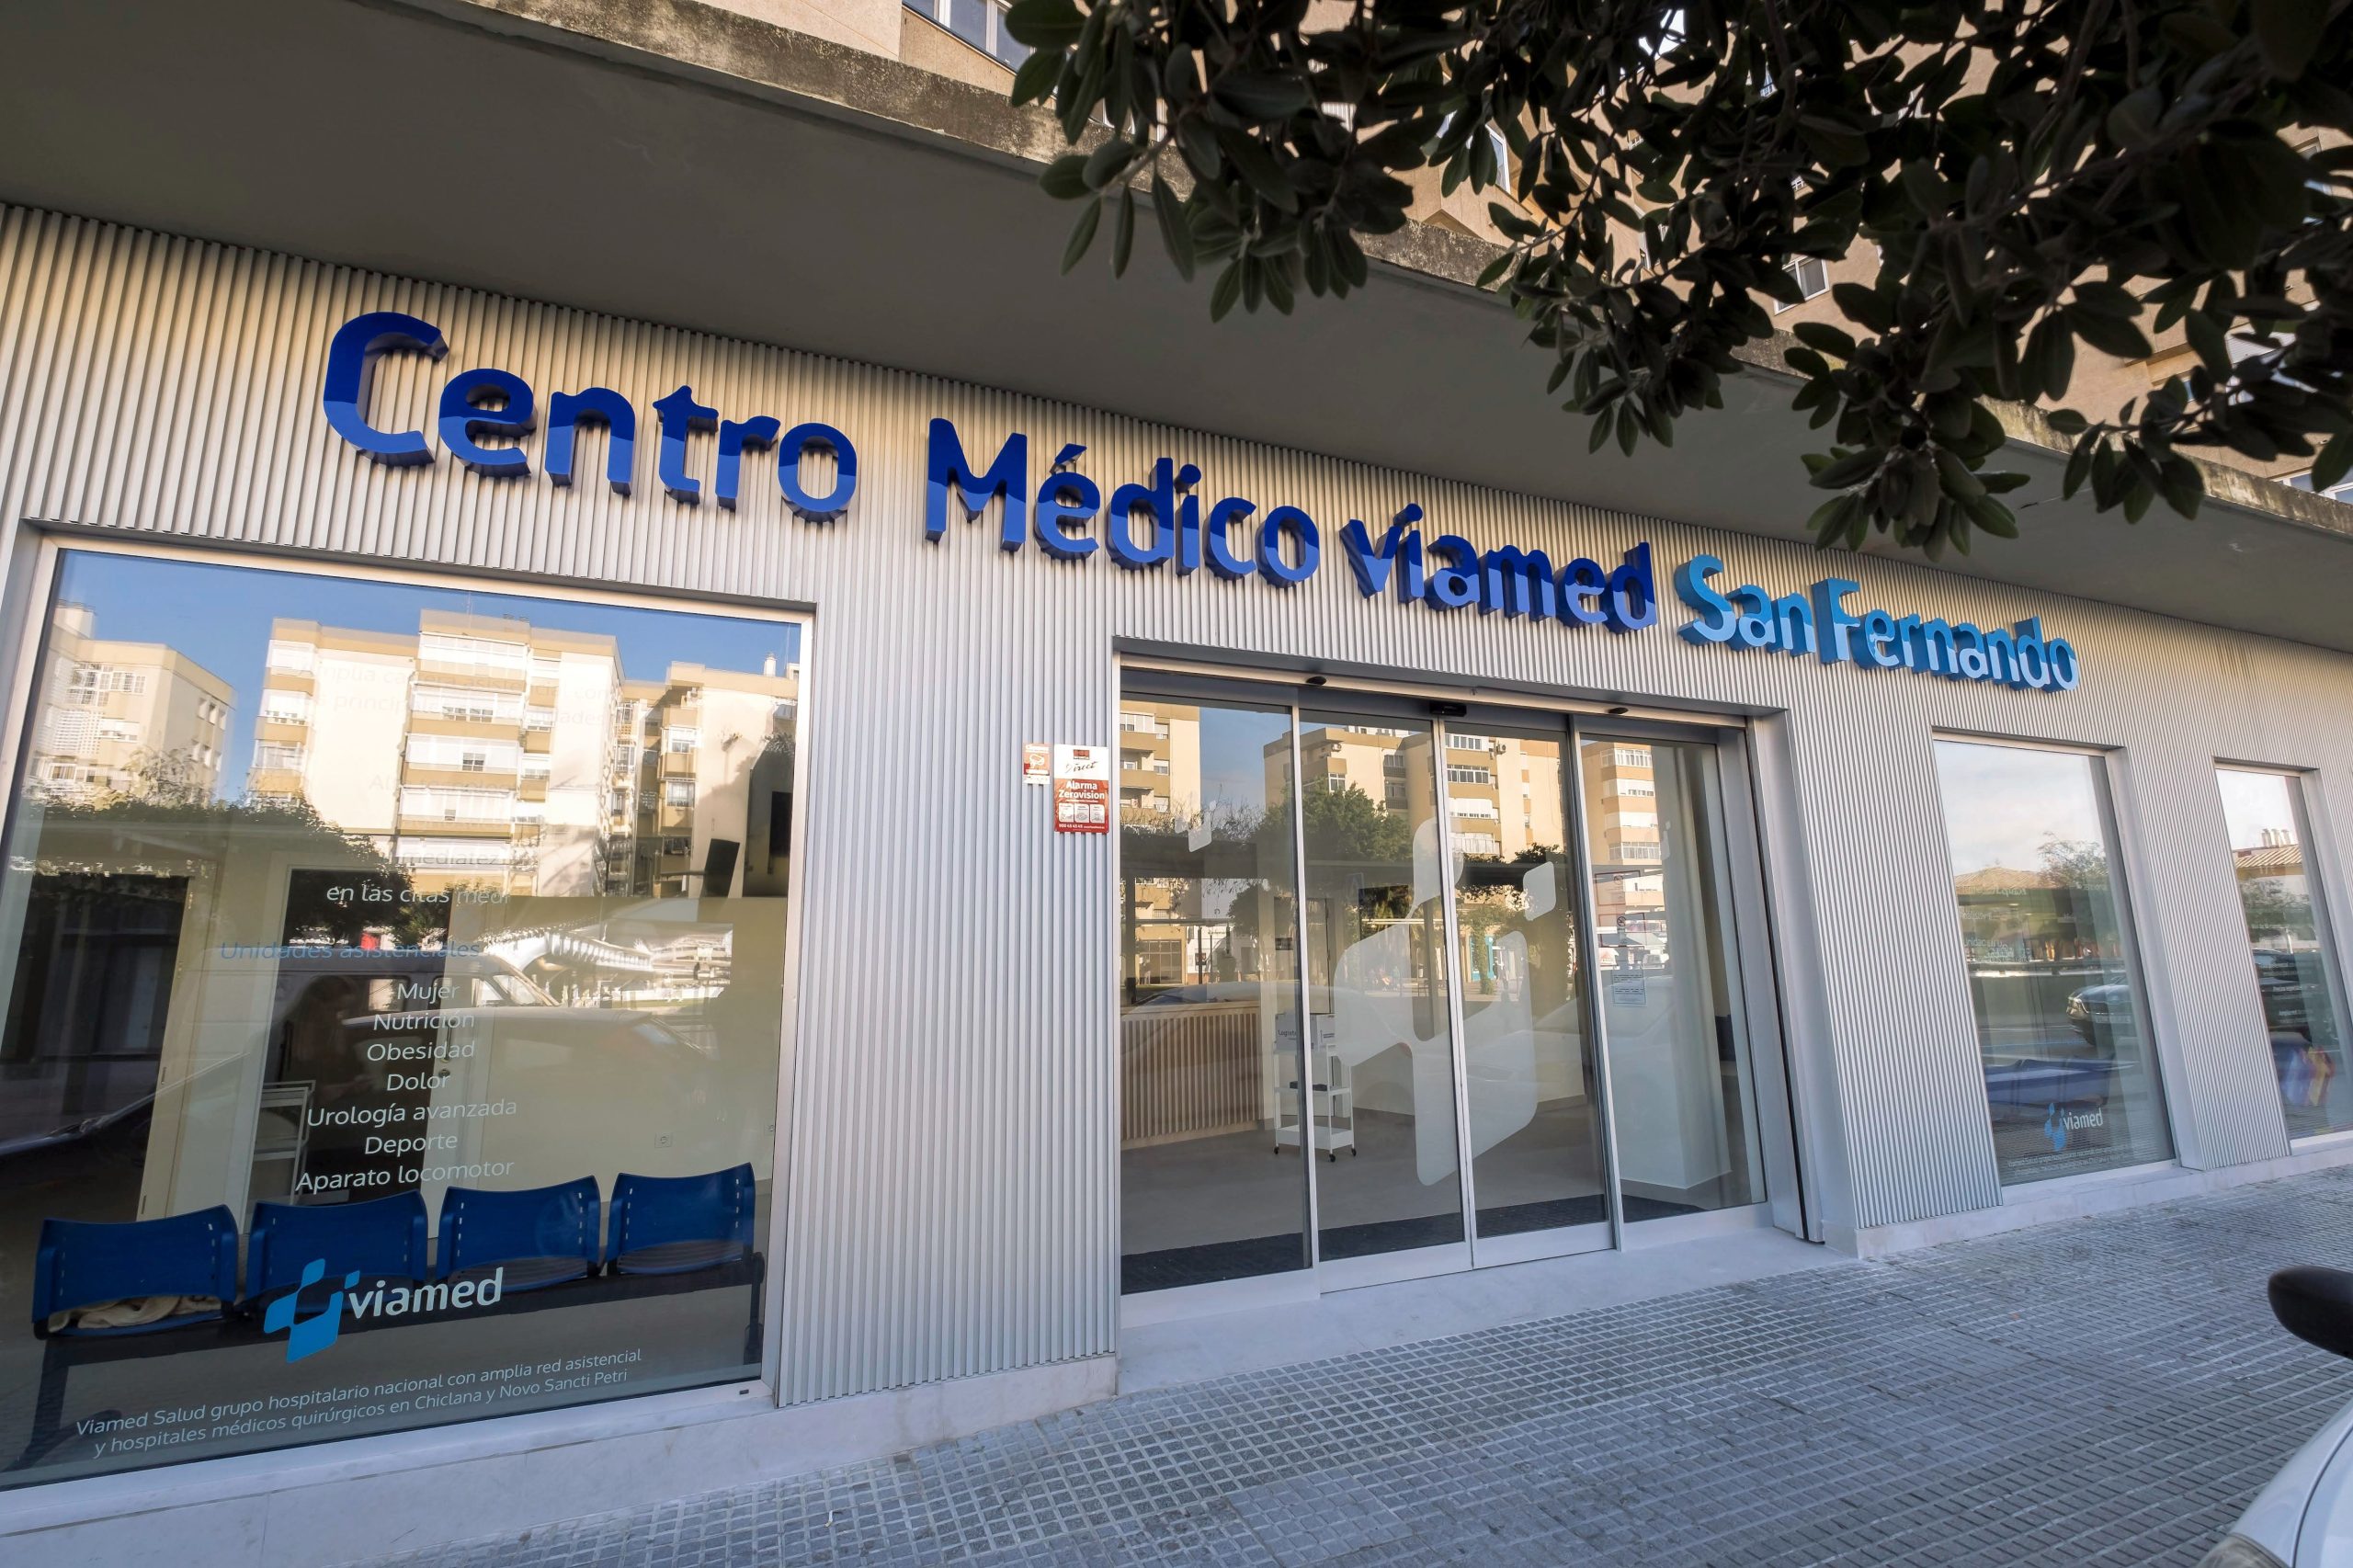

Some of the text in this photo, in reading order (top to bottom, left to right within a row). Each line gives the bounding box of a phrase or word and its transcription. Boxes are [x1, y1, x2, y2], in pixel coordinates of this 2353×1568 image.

[323, 311, 858, 522] Centro
[925, 417, 1320, 588] Médico
[1339, 503, 1658, 635] viamed
[1058, 790, 1106, 800] Zerovision
[1066, 780, 1097, 790] Alarma
[326, 886, 354, 902] en
[362, 880, 393, 902] las
[400, 883, 450, 903] citas
[221, 940, 480, 960] Unidades asistenciales
[397, 982, 459, 1004] Mujer
[373, 1012, 475, 1031] Nutrición
[1278, 1029, 1297, 1038] Logist
[367, 1040, 475, 1062] Obesidad
[386, 1074, 449, 1091] Dolor
[307, 1099, 517, 1128] Urología avanzada
[2063, 1108, 2103, 1131] viamed
[364, 1133, 458, 1157] Deporte
[295, 1161, 515, 1195] Aparato locomotor
[348, 1267, 504, 1319] viamed
[76, 1348, 642, 1436] Viamed Salud grupo hospitalario nacional con amplia red asistencial
[93, 1369, 628, 1460] y hospitales médicos quirúrgicos en Chiclana y Novo Sancti Petri
